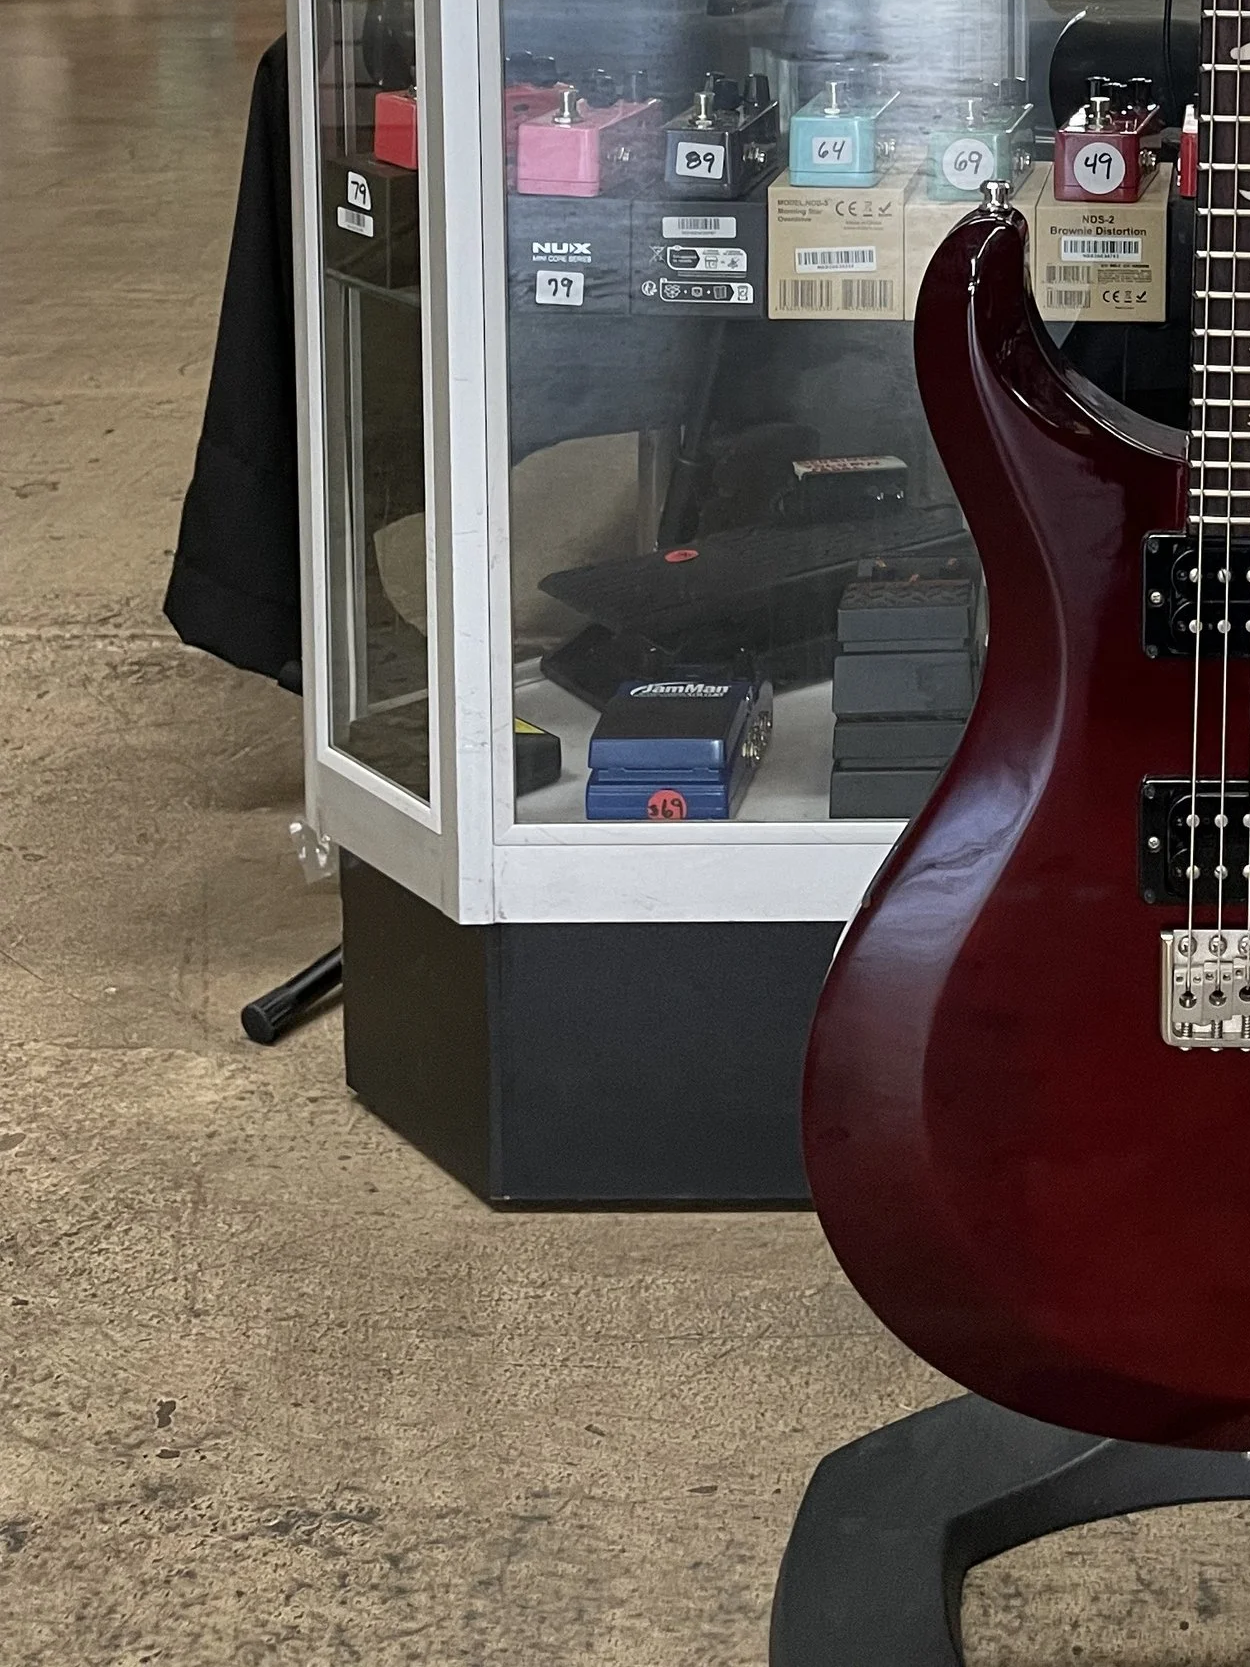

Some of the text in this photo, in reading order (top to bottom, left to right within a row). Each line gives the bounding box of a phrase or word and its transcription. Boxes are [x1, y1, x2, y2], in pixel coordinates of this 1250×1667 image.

[818, 140, 846, 160] 64
[686, 151, 715, 174] 89
[953, 151, 982, 175] 69
[1084, 152, 1112, 180] 49
[350, 180, 367, 206] 79
[1082, 215, 1115, 224] NDS-2
[1050, 226, 1147, 236] Brownie Distortion
[532, 242, 592, 255] NUX
[547, 277, 574, 299] 79
[640, 683, 730, 694] JamMan
